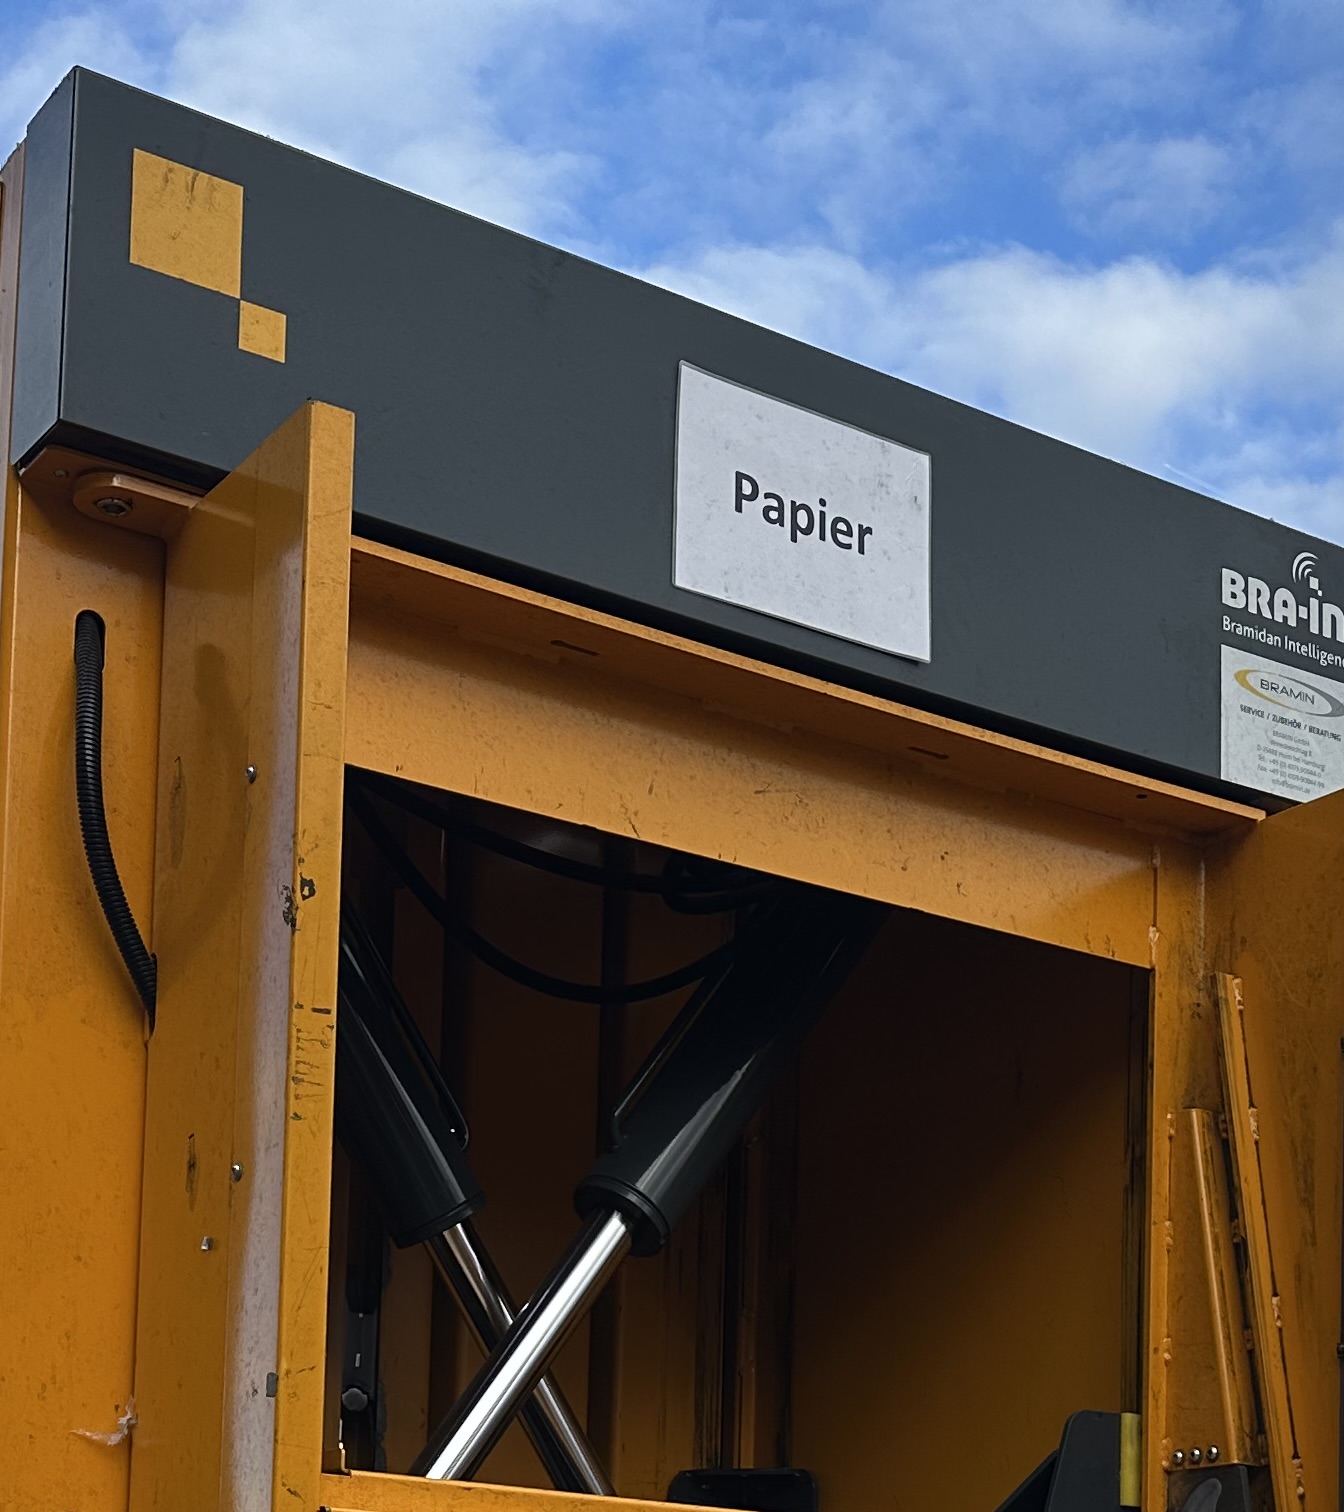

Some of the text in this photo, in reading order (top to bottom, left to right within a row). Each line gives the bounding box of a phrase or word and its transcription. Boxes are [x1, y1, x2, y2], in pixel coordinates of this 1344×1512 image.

[734, 470, 873, 556] Papier
[1222, 615, 1282, 648] Bramidan
[1259, 679, 1315, 705] BRAMIN
[1239, 704, 1265, 719] SERVICE
